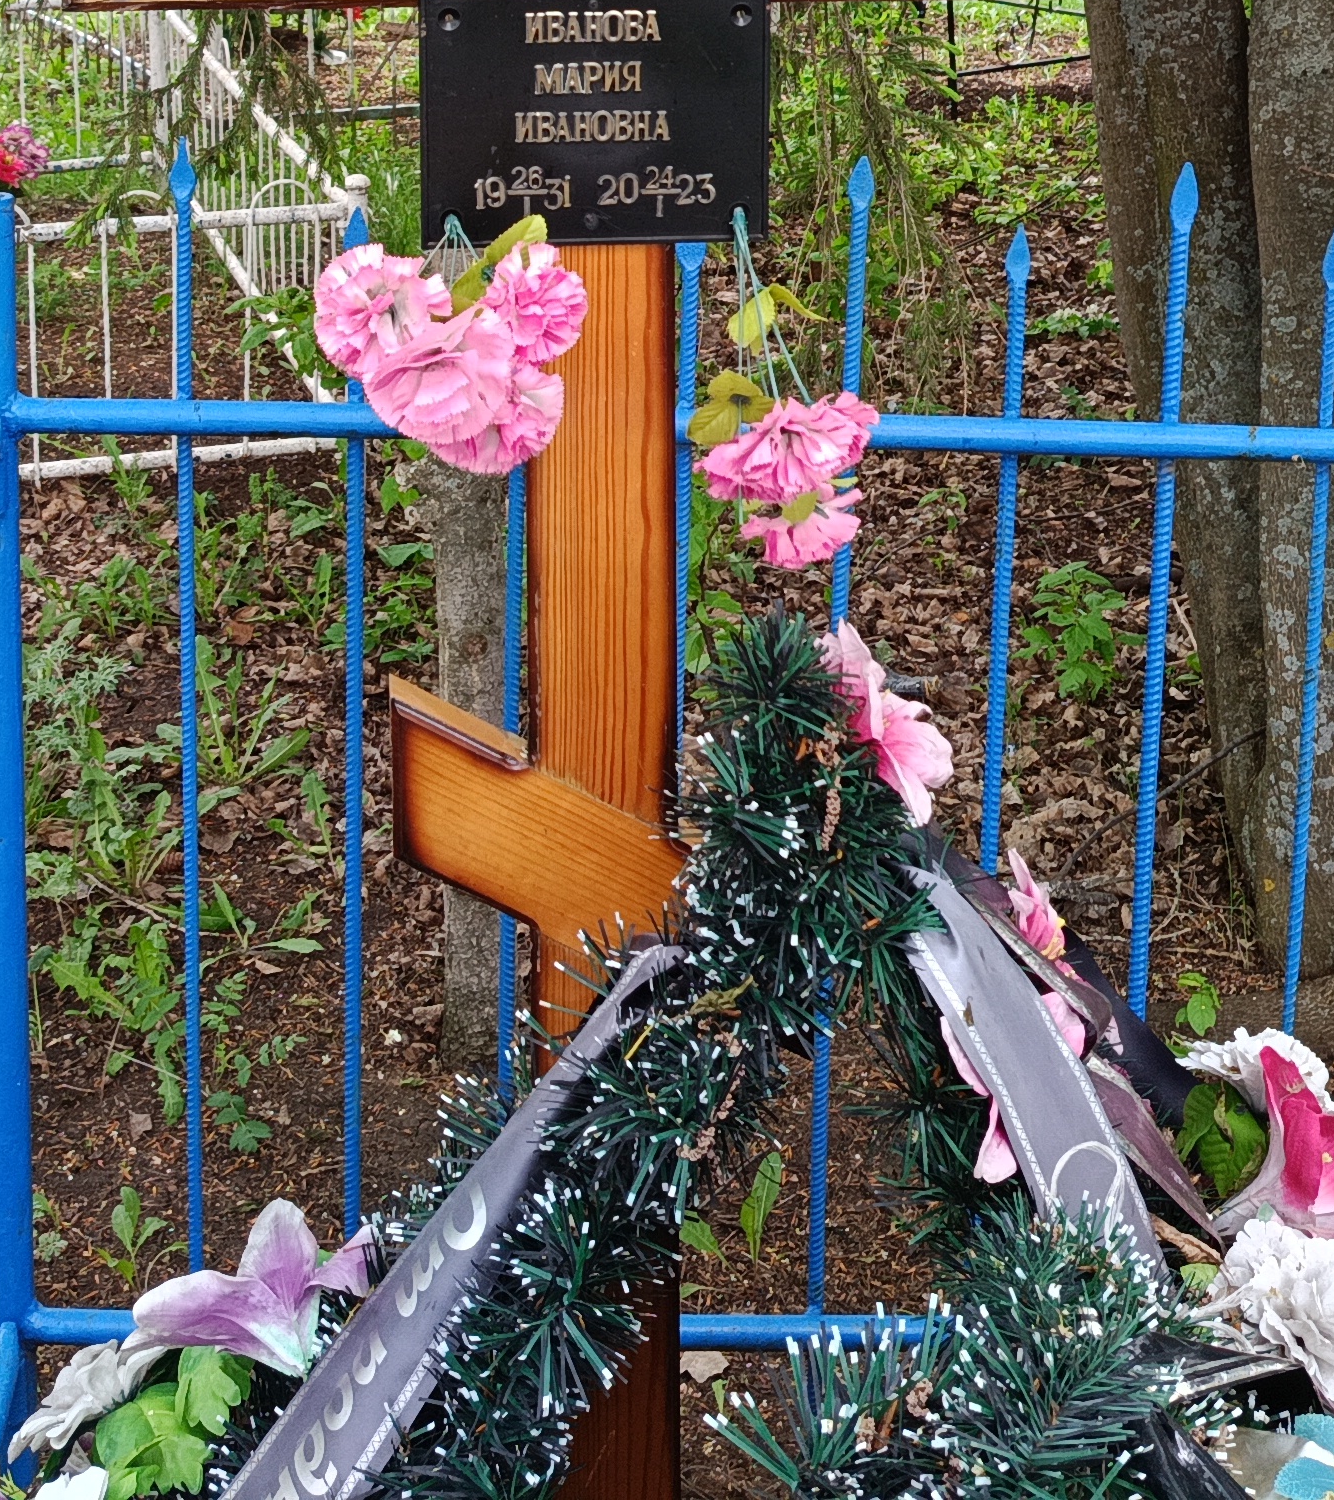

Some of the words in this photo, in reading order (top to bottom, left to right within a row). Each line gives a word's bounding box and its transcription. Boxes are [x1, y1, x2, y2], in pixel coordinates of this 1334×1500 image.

[524, 9, 661, 44] ИВАНОВА
[534, 60, 641, 95] МАРИЯ
[514, 108, 670, 143] ИВАНОВНА
